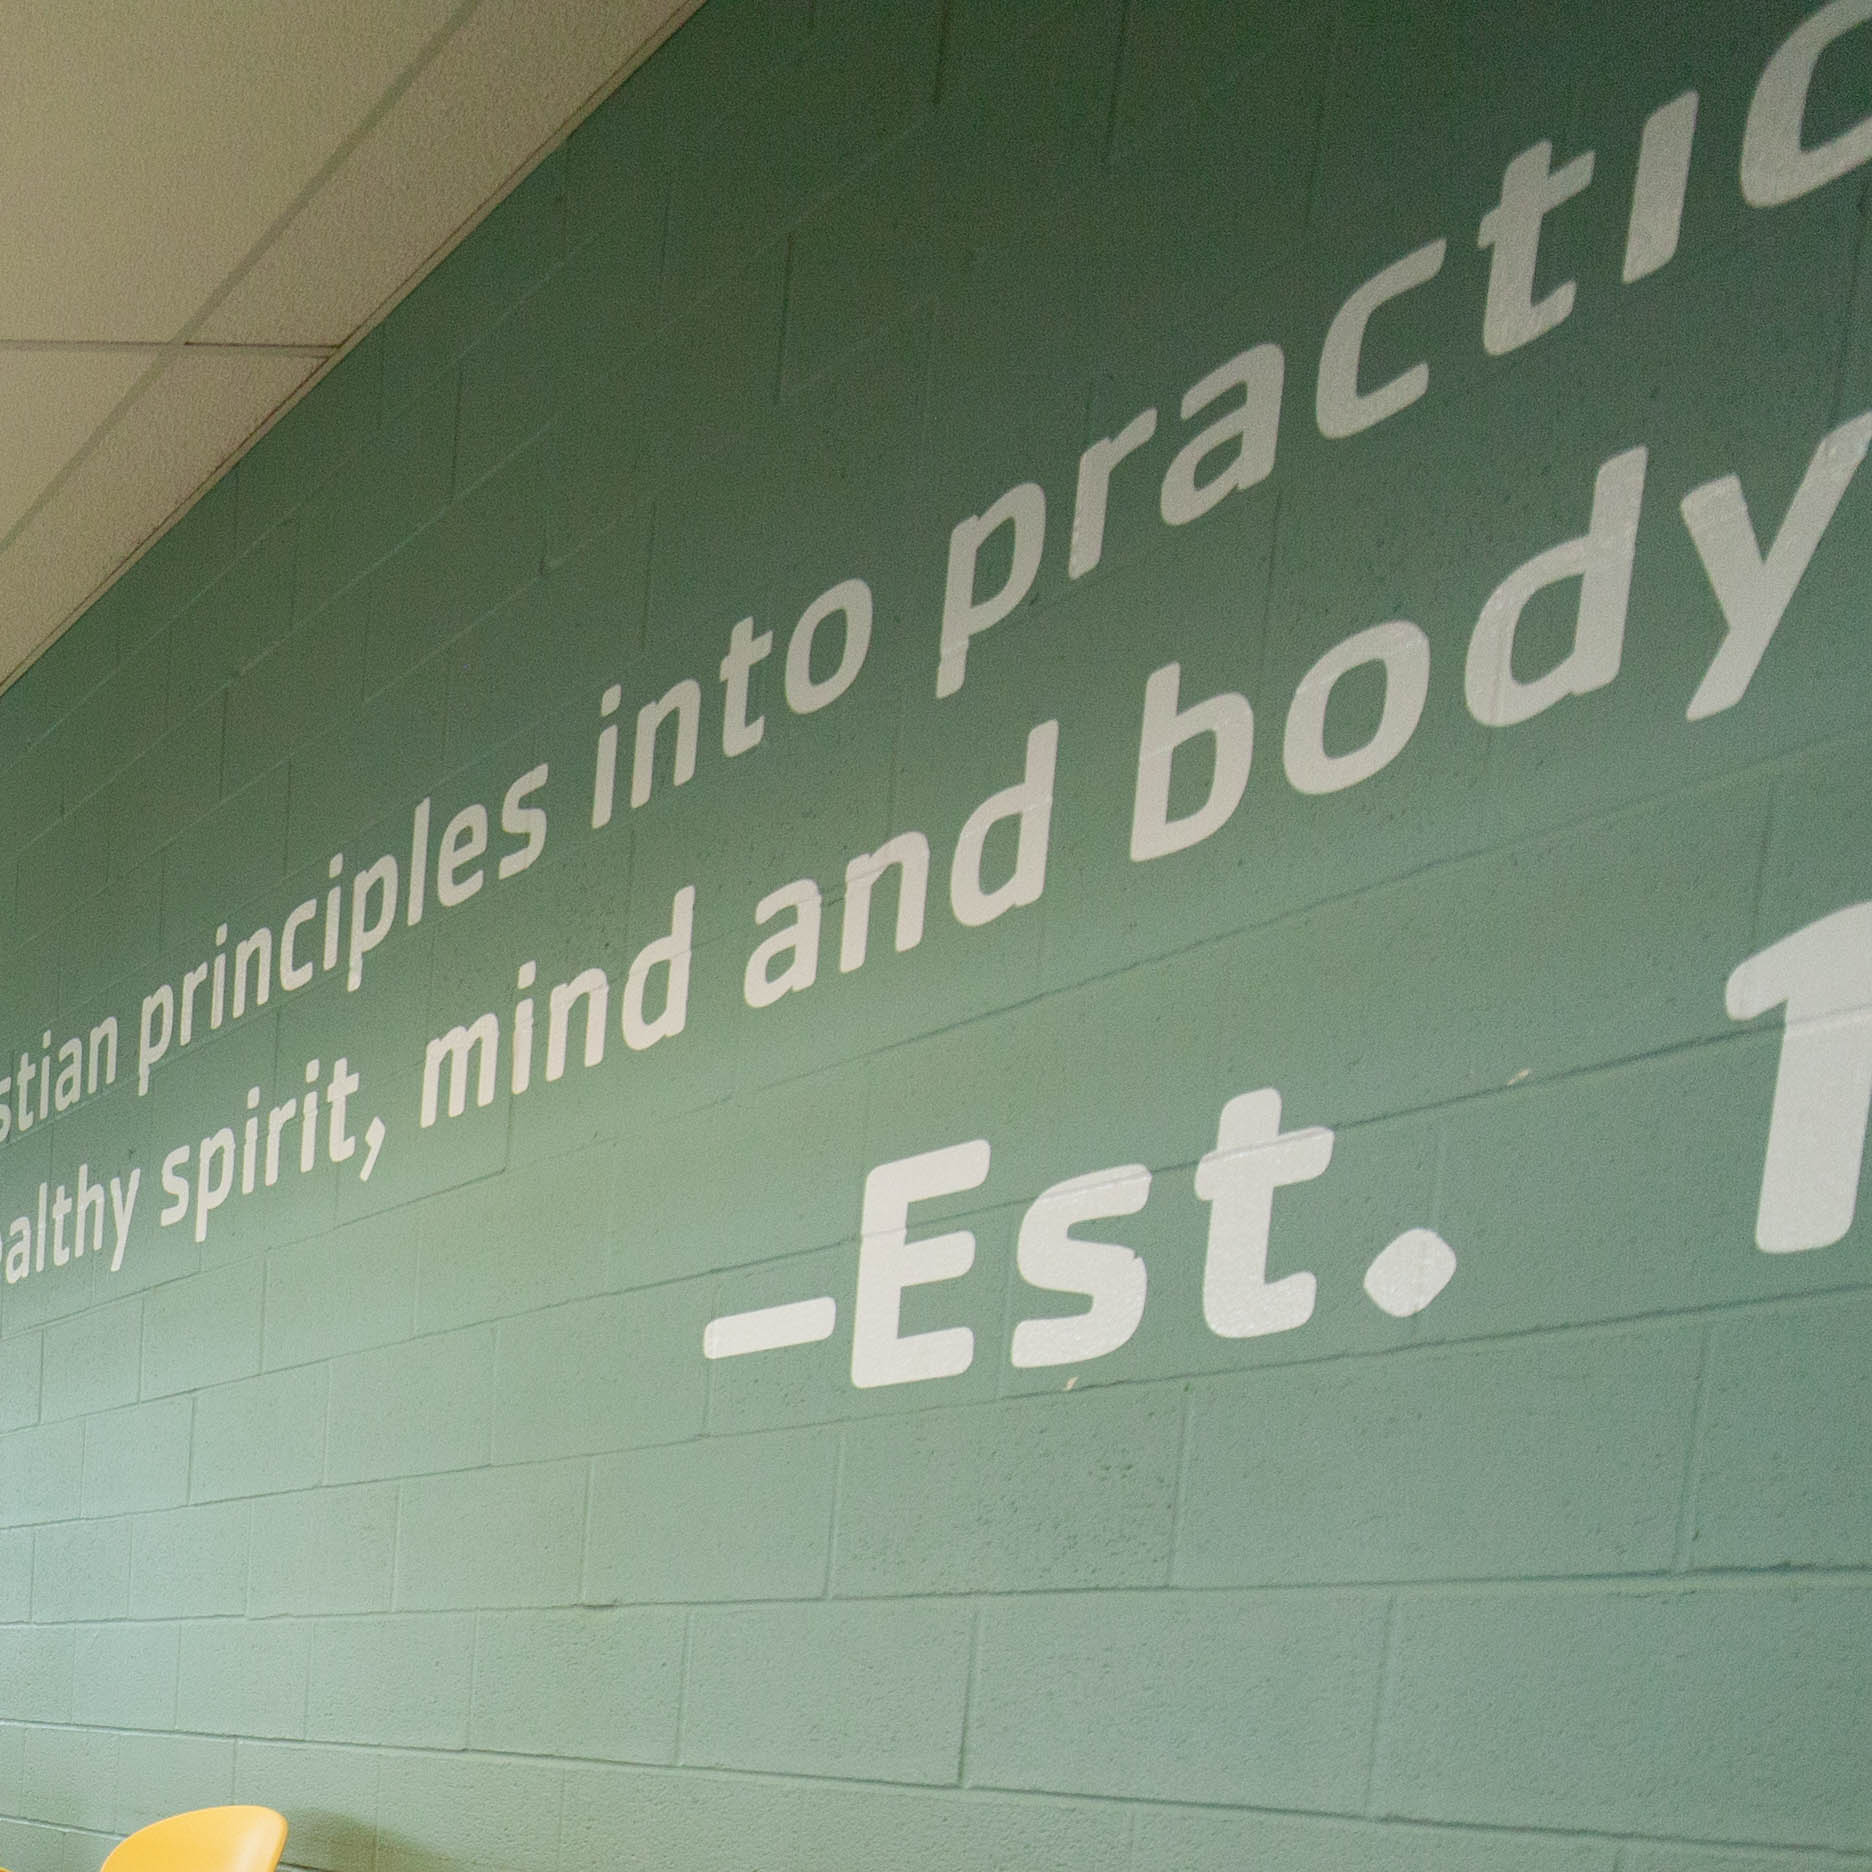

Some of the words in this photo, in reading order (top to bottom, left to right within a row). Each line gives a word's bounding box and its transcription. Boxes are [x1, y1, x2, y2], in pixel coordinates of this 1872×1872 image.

[138, 763, 549, 1097] principles
[592, 577, 873, 830] into
[161, 1056, 386, 1243] spirit,
[420, 886, 695, 1129] mind
[743, 718, 1058, 1009] and
[1130, 410, 1872, 864] body
